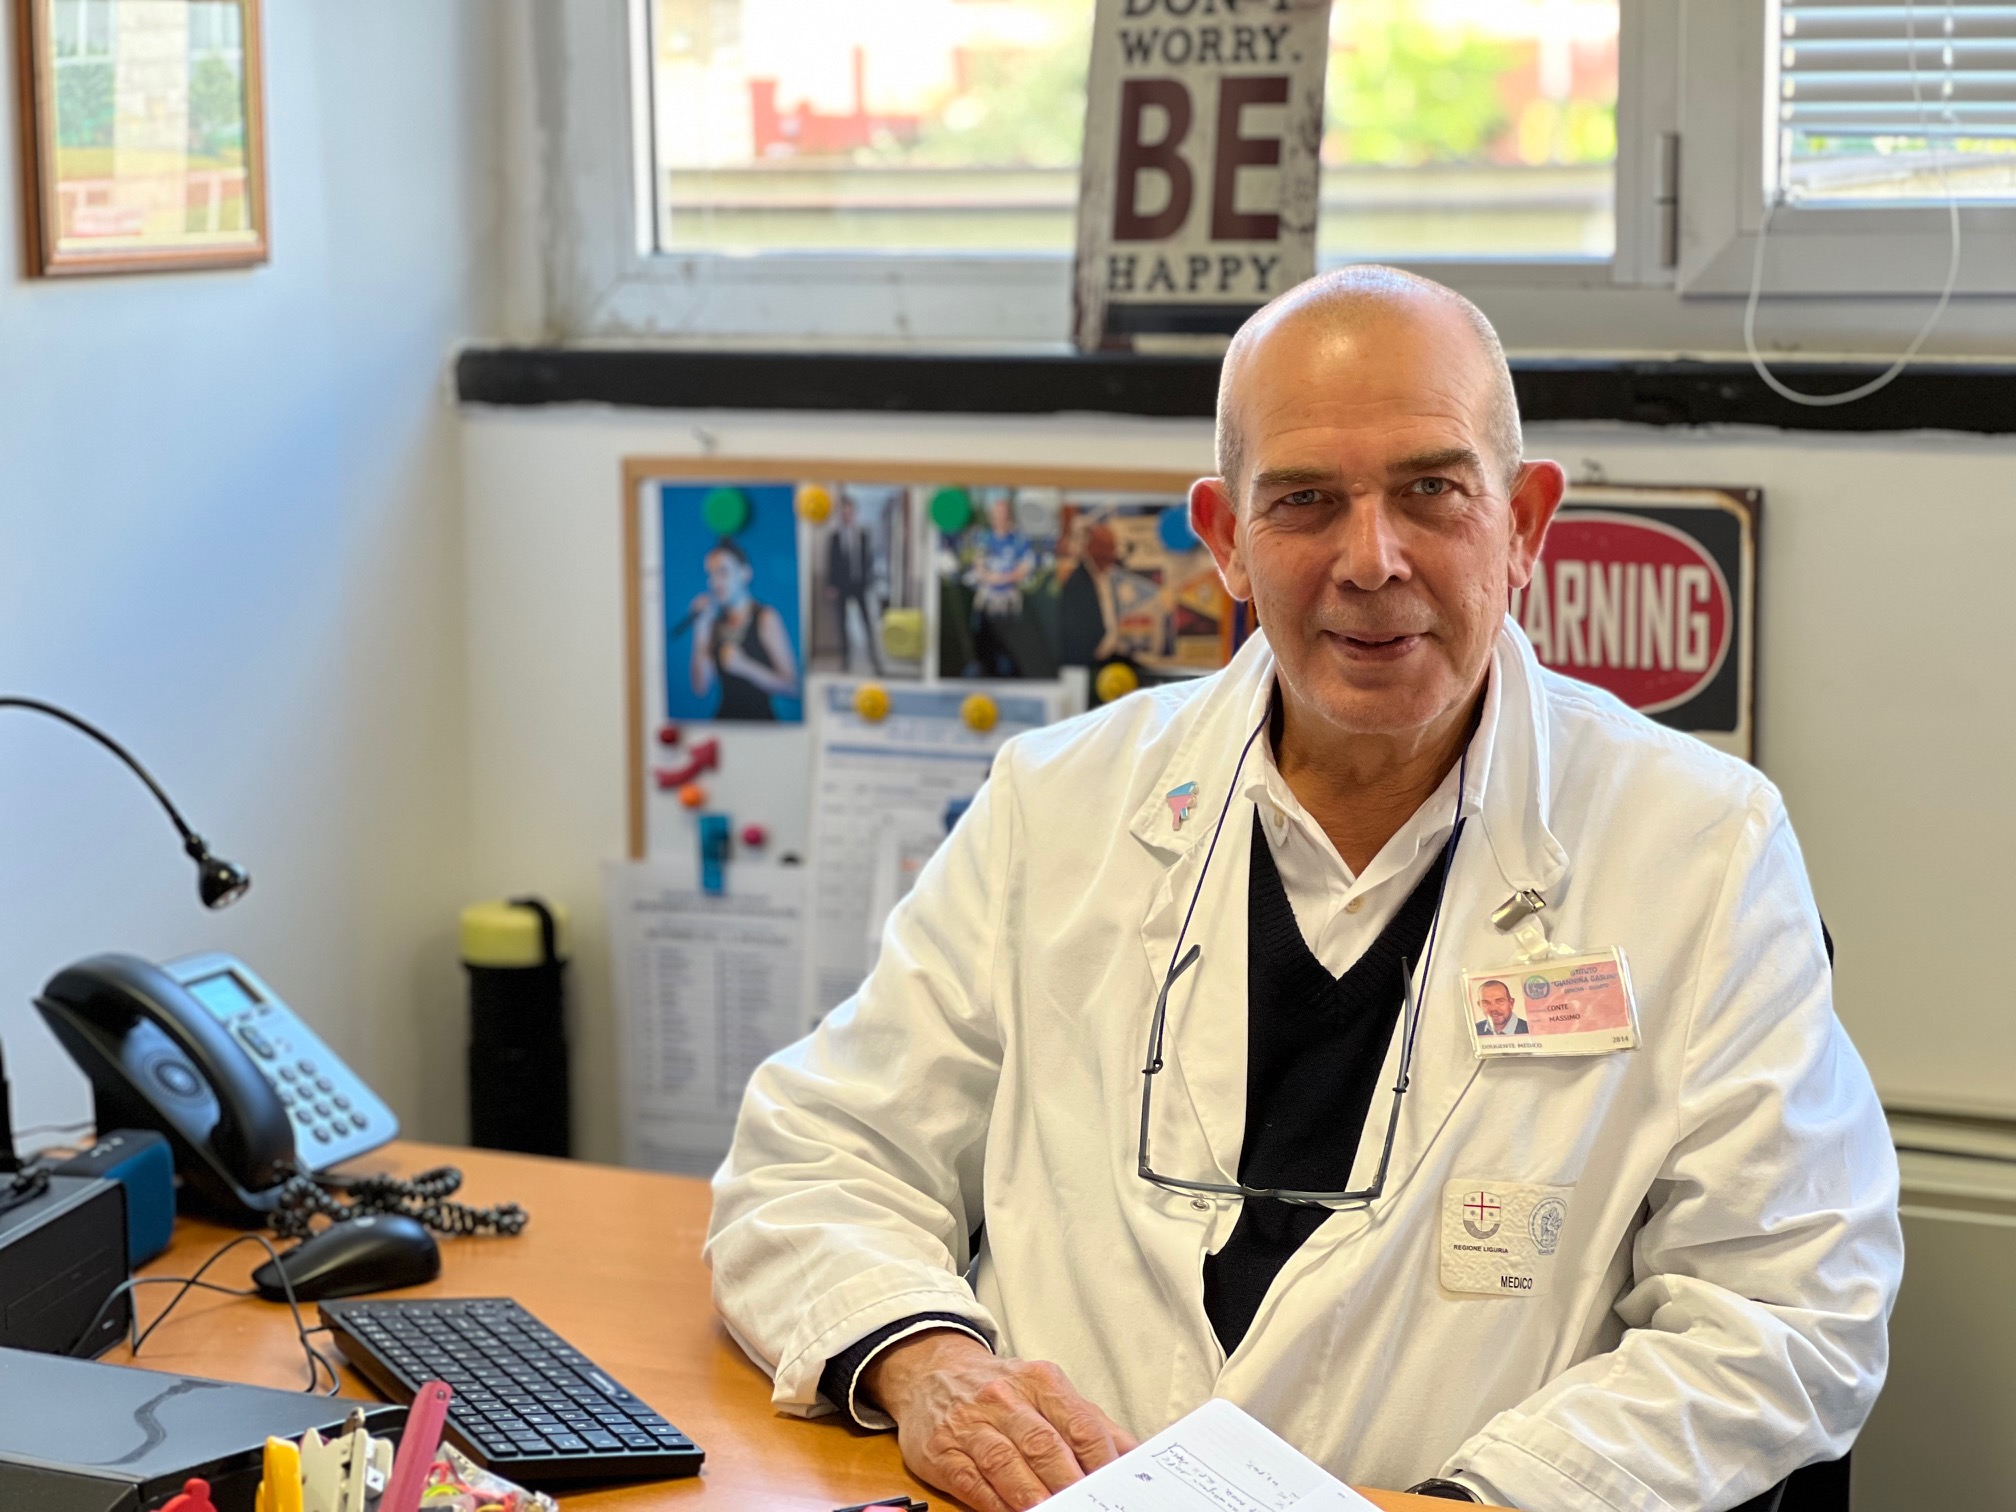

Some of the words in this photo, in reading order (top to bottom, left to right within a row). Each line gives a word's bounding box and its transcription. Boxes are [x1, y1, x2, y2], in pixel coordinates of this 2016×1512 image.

[1119, 26, 1302, 65] WORRY.
[1113, 76, 1290, 240] BE
[1107, 255, 1280, 292] HAPPY
[1510, 560, 1711, 672] ARNING
[1547, 1004, 1569, 1012] CONTE
[1549, 1014, 1581, 1022] MASSIMO
[1453, 1244, 1482, 1252] REGIONE
[1483, 1246, 1509, 1254] LIGURIA
[1500, 1275, 1533, 1290] MEDICO
